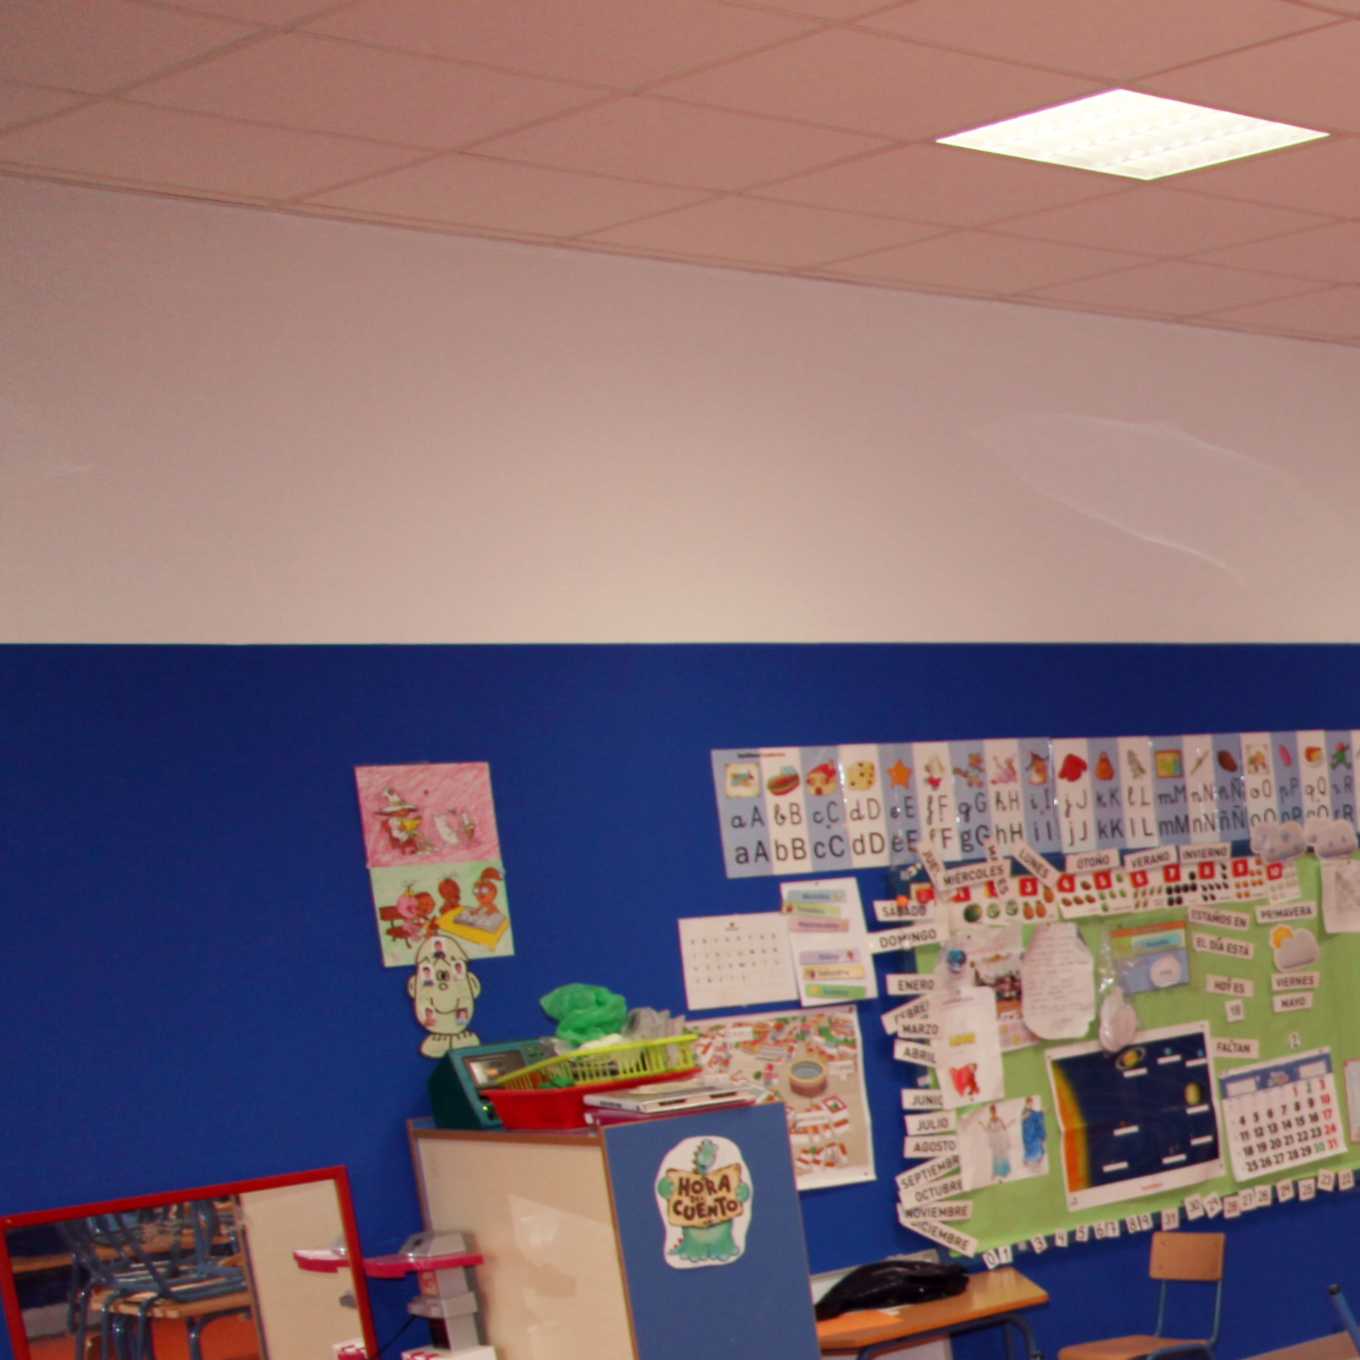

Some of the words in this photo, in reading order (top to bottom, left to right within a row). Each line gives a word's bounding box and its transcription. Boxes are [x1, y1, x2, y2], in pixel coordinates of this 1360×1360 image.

[898, 979, 935, 991] ENERO
[1276, 975, 1314, 988] VIERNES
[1281, 996, 1306, 1009] MAYO
[902, 1022, 939, 1035] MARZO
[917, 1117, 949, 1131] JULIO
[913, 1140, 956, 1152] AGOSTO
[901, 1154, 961, 1190] SEPTIEMBR
[677, 1174, 731, 1197] HORA
[673, 1197, 738, 1221] CUENTO
[904, 1204, 969, 1219] NOVIEMBRE
